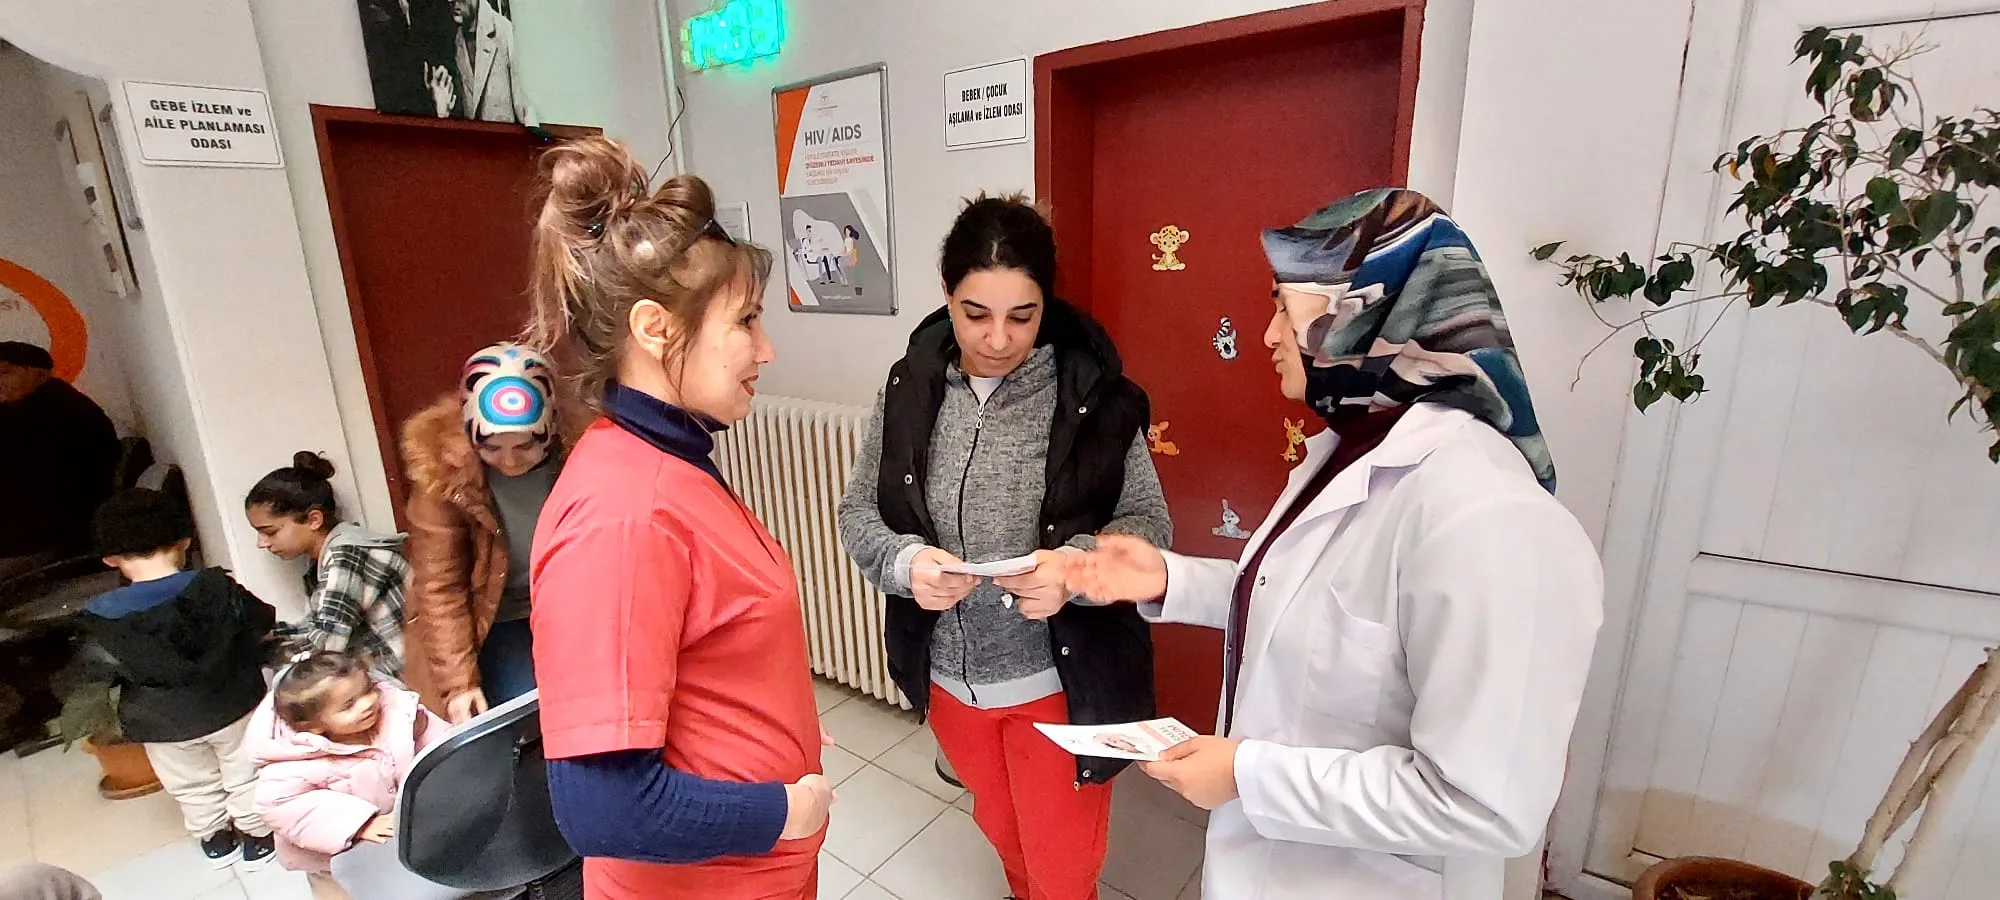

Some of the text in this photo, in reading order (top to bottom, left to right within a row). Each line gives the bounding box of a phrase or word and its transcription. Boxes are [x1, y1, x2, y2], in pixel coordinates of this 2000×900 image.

[962, 88, 980, 102] BEBEK
[986, 83, 1007, 101] ÇOCUK
[150, 100, 252, 116] GEBE İZLEM ve
[949, 103, 1023, 127] AŞILAMA ve İZLEM ODASI
[144, 116, 265, 134] AİLE PLANLAMASI
[190, 138, 231, 149] ODASI
